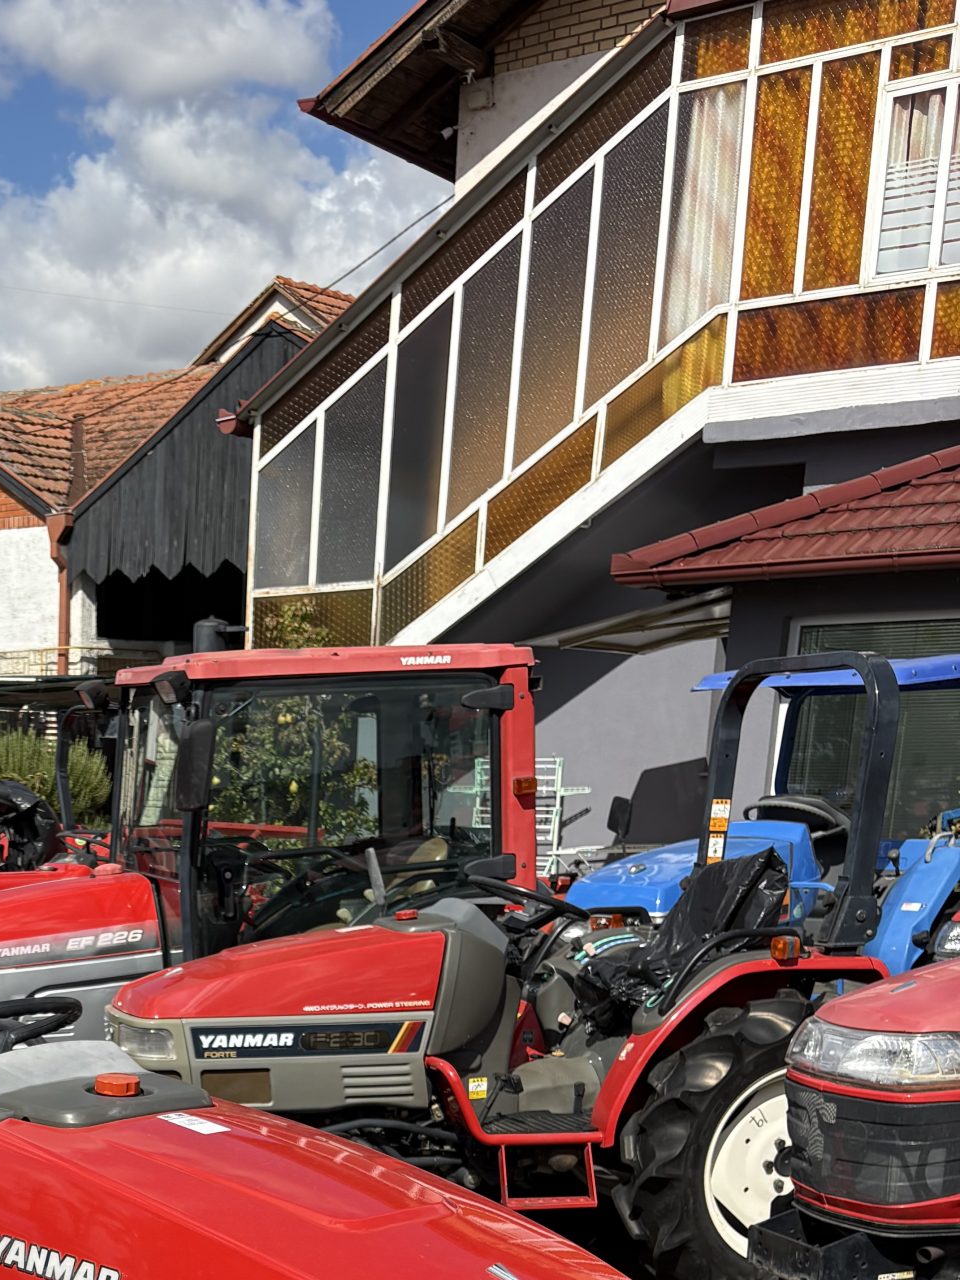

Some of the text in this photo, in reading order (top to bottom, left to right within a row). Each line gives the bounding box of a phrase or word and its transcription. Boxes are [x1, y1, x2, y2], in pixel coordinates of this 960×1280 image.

[400, 655, 452, 666] YANMAR
[66, 935, 95, 951] EF
[96, 930, 144, 948] 226
[199, 1033, 294, 1049] YANMAR
[203, 1051, 237, 1059] FORTE
